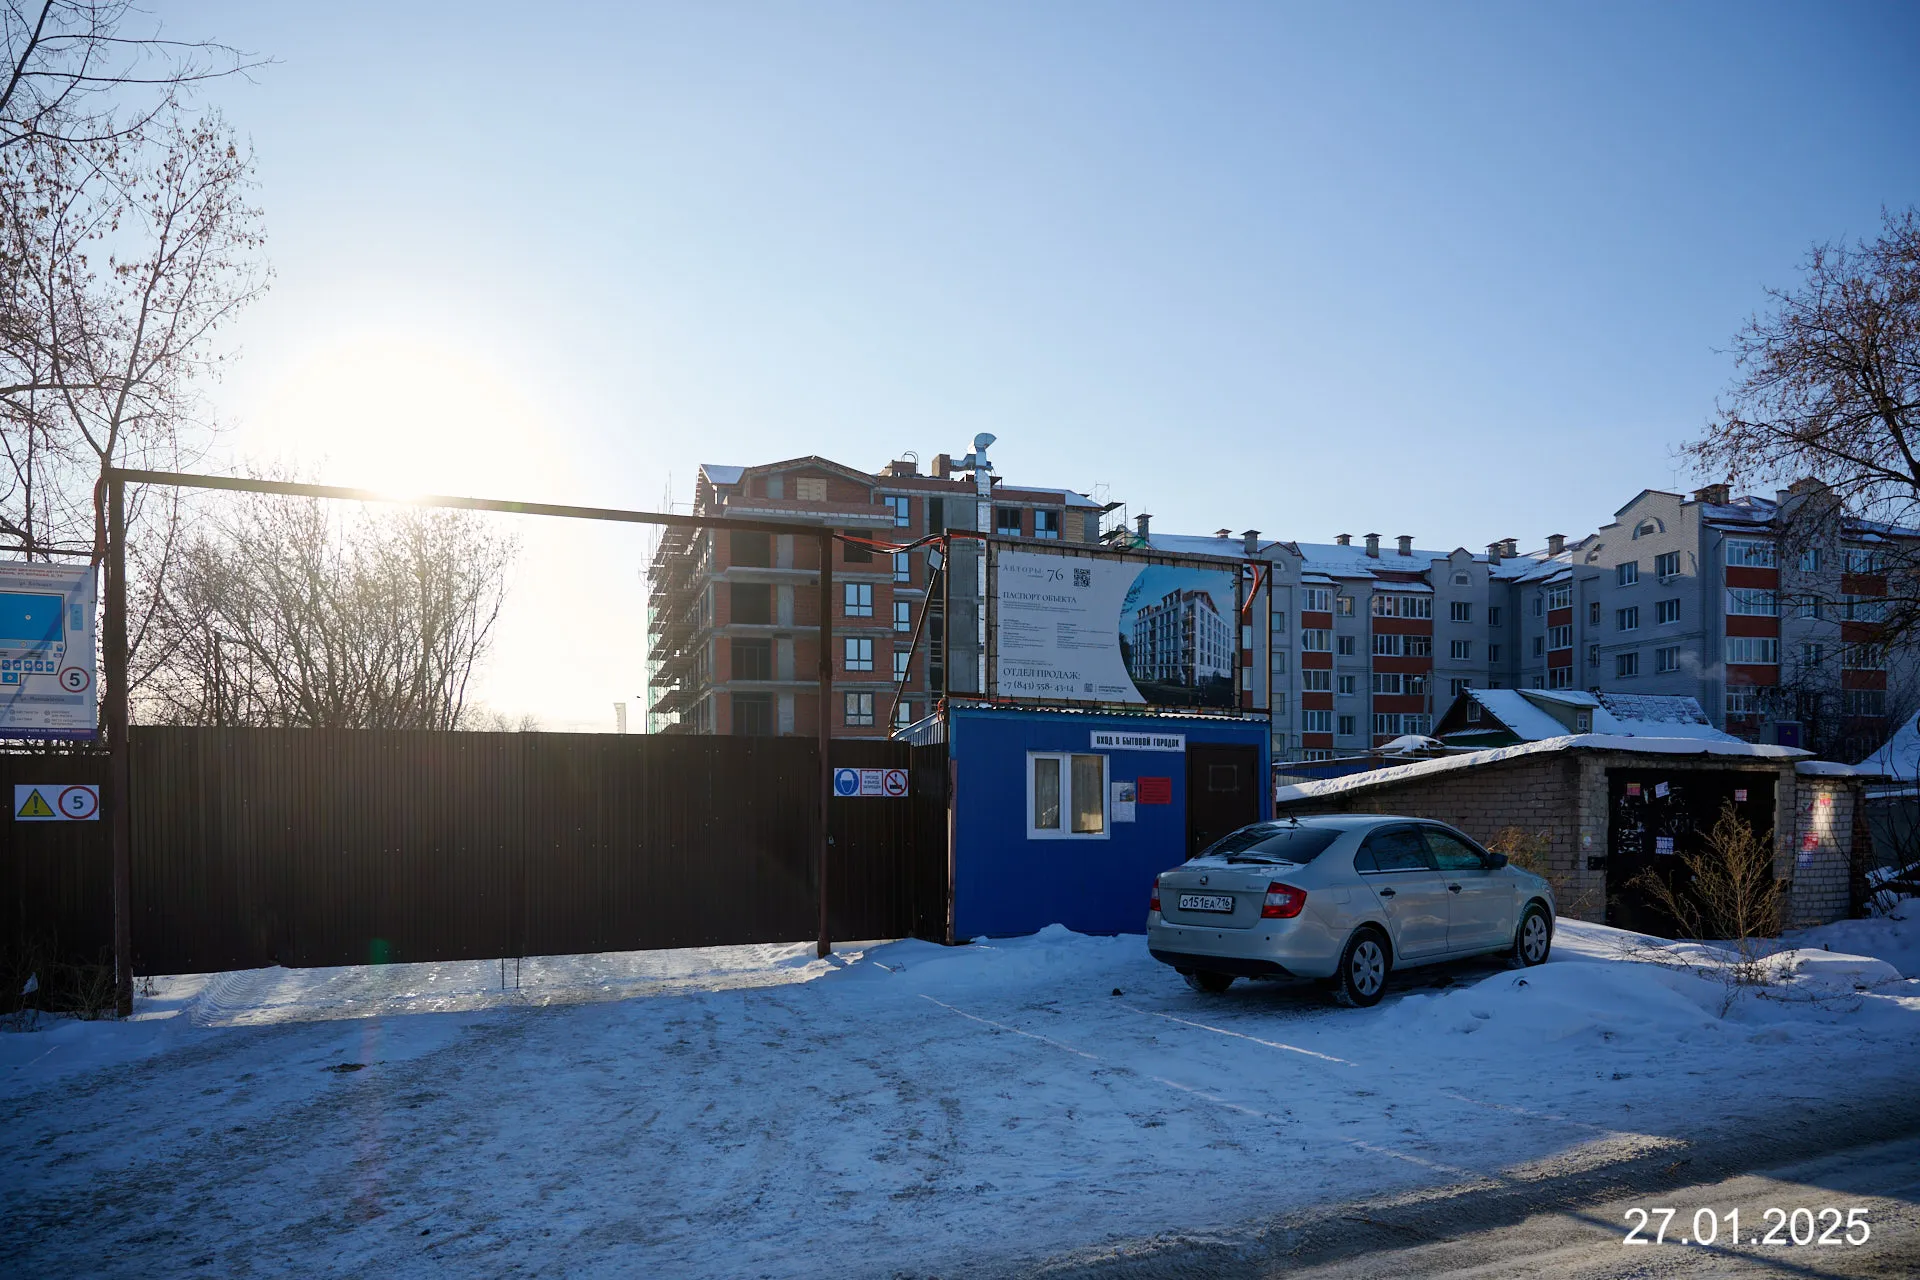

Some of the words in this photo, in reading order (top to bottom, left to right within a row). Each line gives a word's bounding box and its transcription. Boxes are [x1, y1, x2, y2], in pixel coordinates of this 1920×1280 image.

[1003, 564, 1042, 574] АВТОРЫ
[1047, 568, 1064, 583] 76
[1003, 591, 1040, 601] ПАСПОРТ
[1042, 595, 1077, 603] ОБЪЕКТА
[69, 672, 80, 687] 5
[1003, 667, 1034, 677] ОТДЕЛ
[1036, 669, 1081, 680] ПРОДАЖ:
[1096, 736, 1113, 746] ВХОД
[1115, 736, 1120, 745] В
[1122, 736, 1151, 747] БЫТОВОЙ
[1153, 738, 1180, 748] ГОРОДОК
[73, 796, 84, 810] 5
